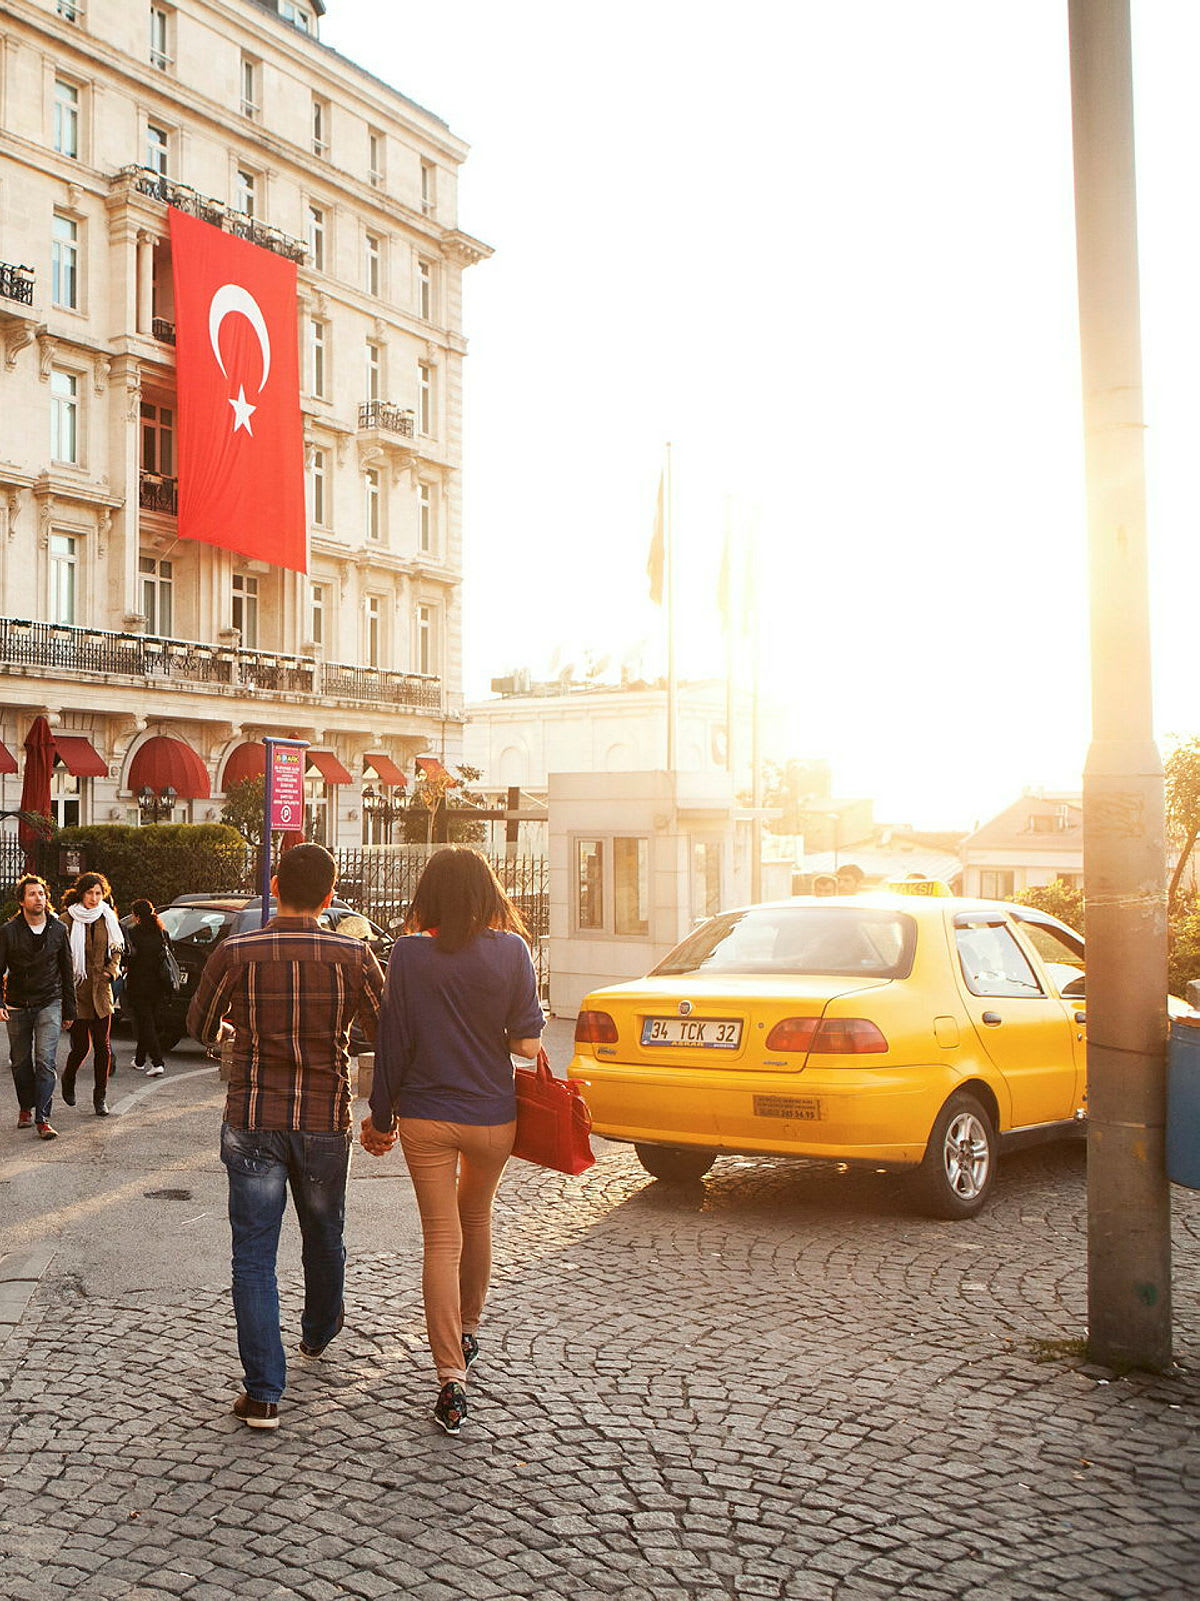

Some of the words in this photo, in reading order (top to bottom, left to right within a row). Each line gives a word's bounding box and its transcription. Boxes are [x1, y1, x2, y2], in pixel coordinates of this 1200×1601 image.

[652, 1022, 668, 1039] 34
[681, 1023, 706, 1041] TCK
[716, 1025, 735, 1042] 32
